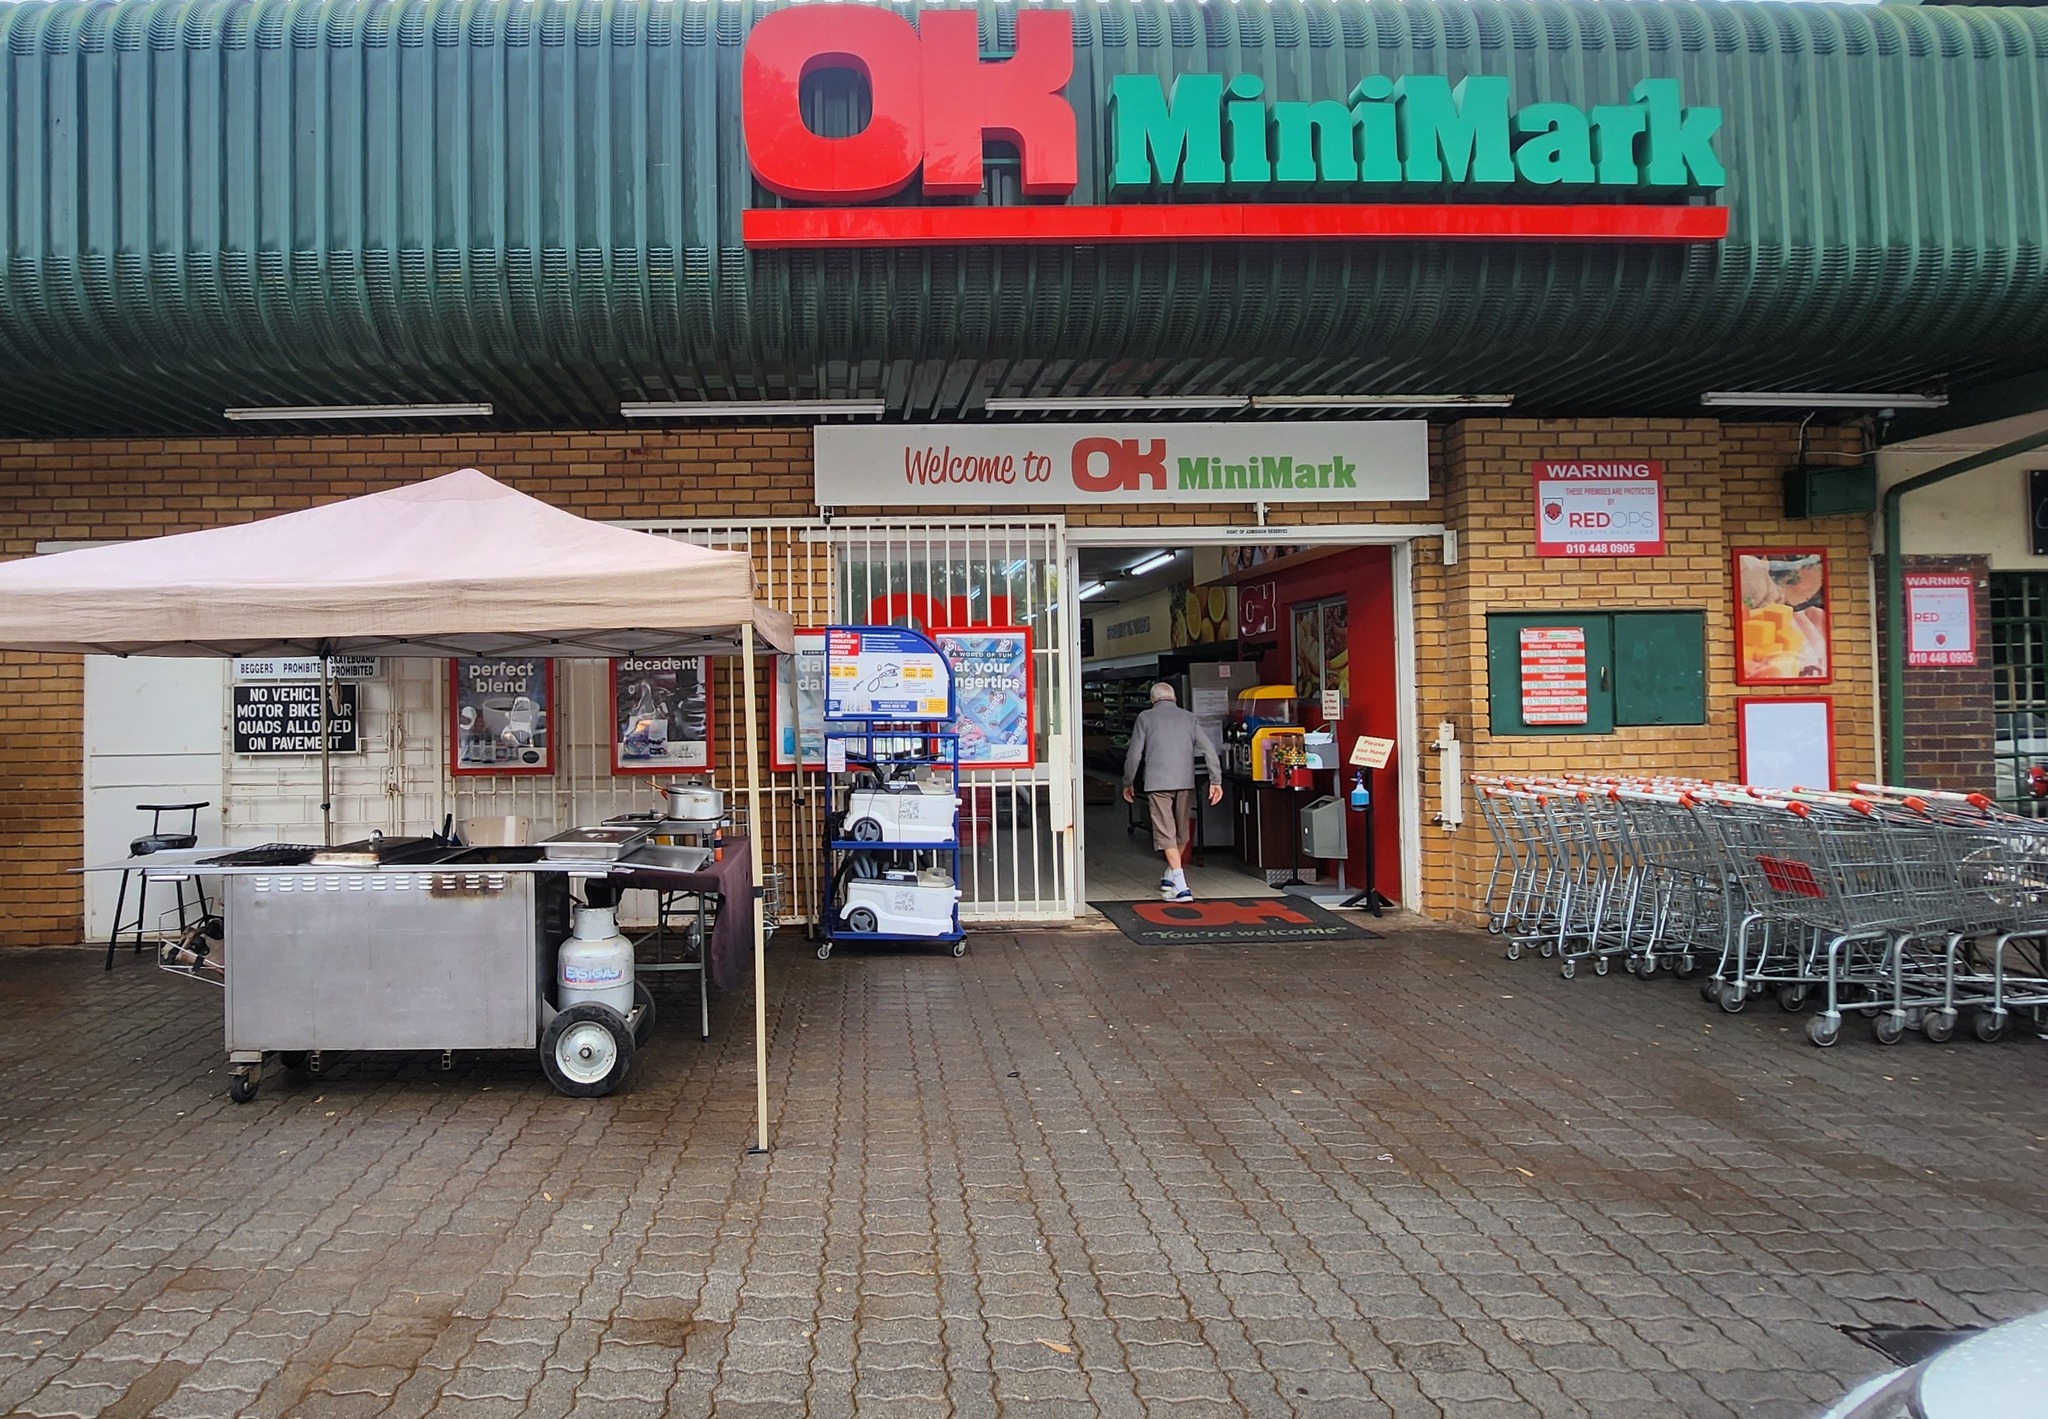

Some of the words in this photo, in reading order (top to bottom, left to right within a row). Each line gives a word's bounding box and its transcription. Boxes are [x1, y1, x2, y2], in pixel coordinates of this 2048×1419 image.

[741, 3, 1078, 201] OK
[1109, 74, 1727, 193] MiniMark
[905, 446, 1016, 486] Welcome
[1023, 450, 1052, 483] to
[1071, 437, 1167, 493] OK
[1177, 455, 1357, 490] MiniMark
[1546, 464, 1650, 478] WARNING
[1565, 488, 1584, 496] THESE
[1624, 487, 1656, 495] PROTECTED
[1607, 498, 1615, 506] BY
[1566, 544, 1586, 554] 010
[1588, 544, 1608, 553] 448
[1610, 543, 1636, 553] 0905
[1906, 576, 1971, 586] WARNING
[624, 657, 698, 671] decadent
[1909, 652, 1928, 664] 010
[1929, 652, 1948, 664] 448
[1949, 652, 1974, 663] 0905
[240, 663, 274, 674] BEGGERS
[283, 662, 321, 674] PROHIBITE
[331, 665, 374, 676] PROHIBITED
[469, 661, 534, 678] perfect
[954, 660, 970, 673] at
[975, 662, 1011, 677] your
[476, 679, 527, 693] blend
[955, 675, 1020, 690] ngertips
[250, 688, 268, 702] NO
[272, 687, 333, 701] VEHICL
[237, 703, 283, 718] MOTOR
[289, 703, 322, 718] BIKE
[238, 720, 282, 734] QUADS
[248, 736, 267, 750] ON
[1363, 740, 1385, 748] Please
[1354, 755, 1383, 764] Sanitizer
[1131, 900, 1314, 927] OK
